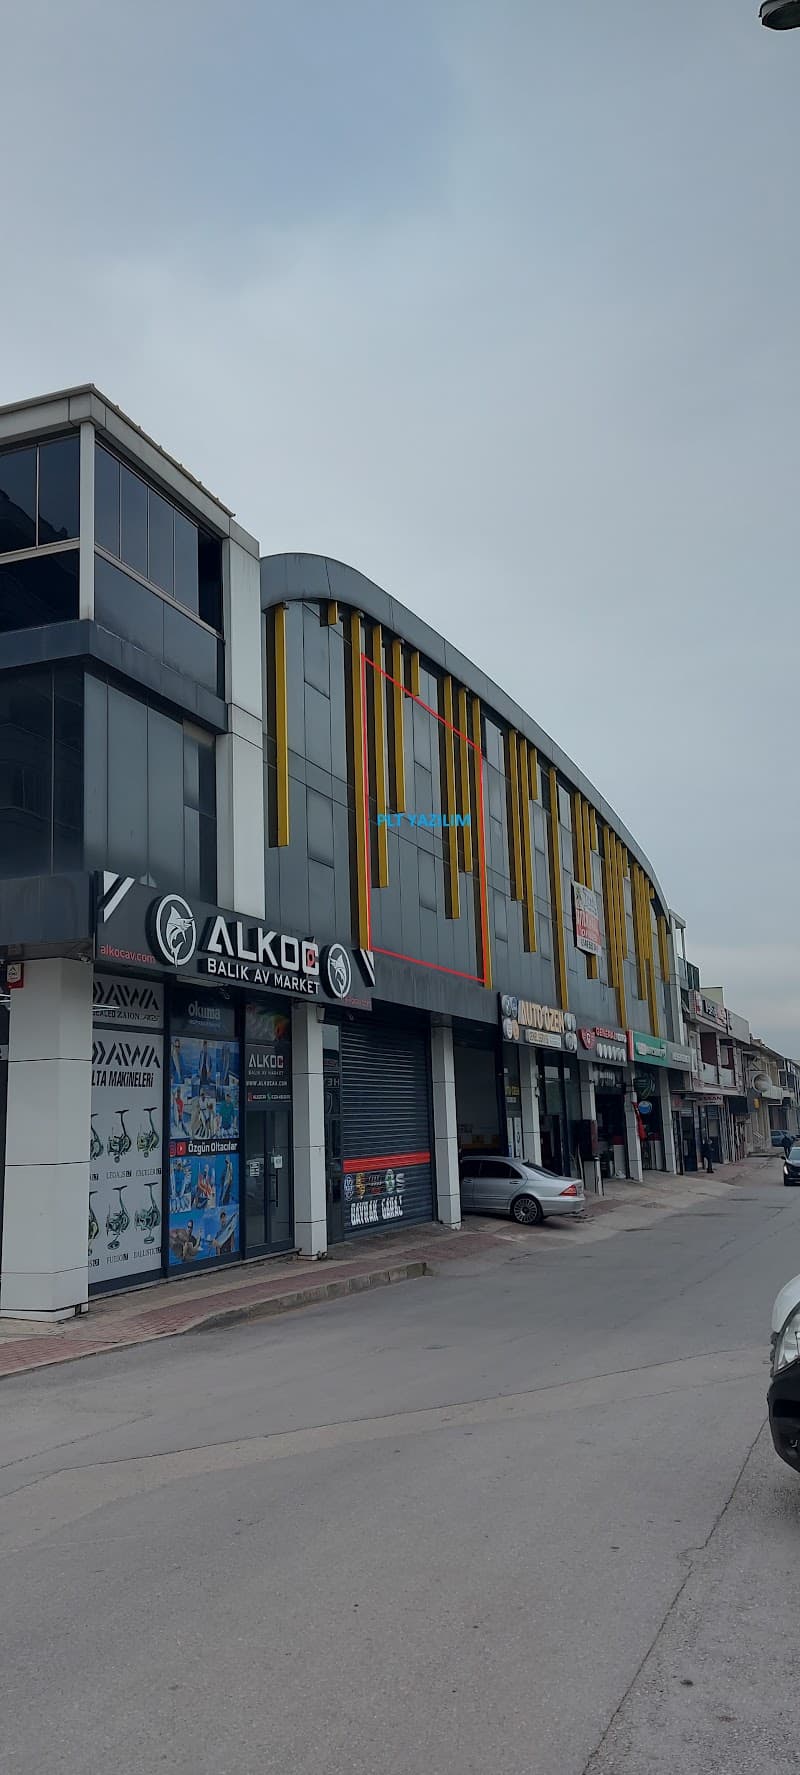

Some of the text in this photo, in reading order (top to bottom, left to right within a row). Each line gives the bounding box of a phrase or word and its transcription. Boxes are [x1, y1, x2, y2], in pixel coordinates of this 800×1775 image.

[100, 943, 156, 964] alkocav.com
[207, 957, 320, 995] BALIK AV MARKET
[188, 1000, 221, 1020] okuma
[518, 999, 544, 1030] AUTO
[92, 1069, 107, 1087] LTA
[188, 1140, 238, 1155] Özgün Oltacılar
